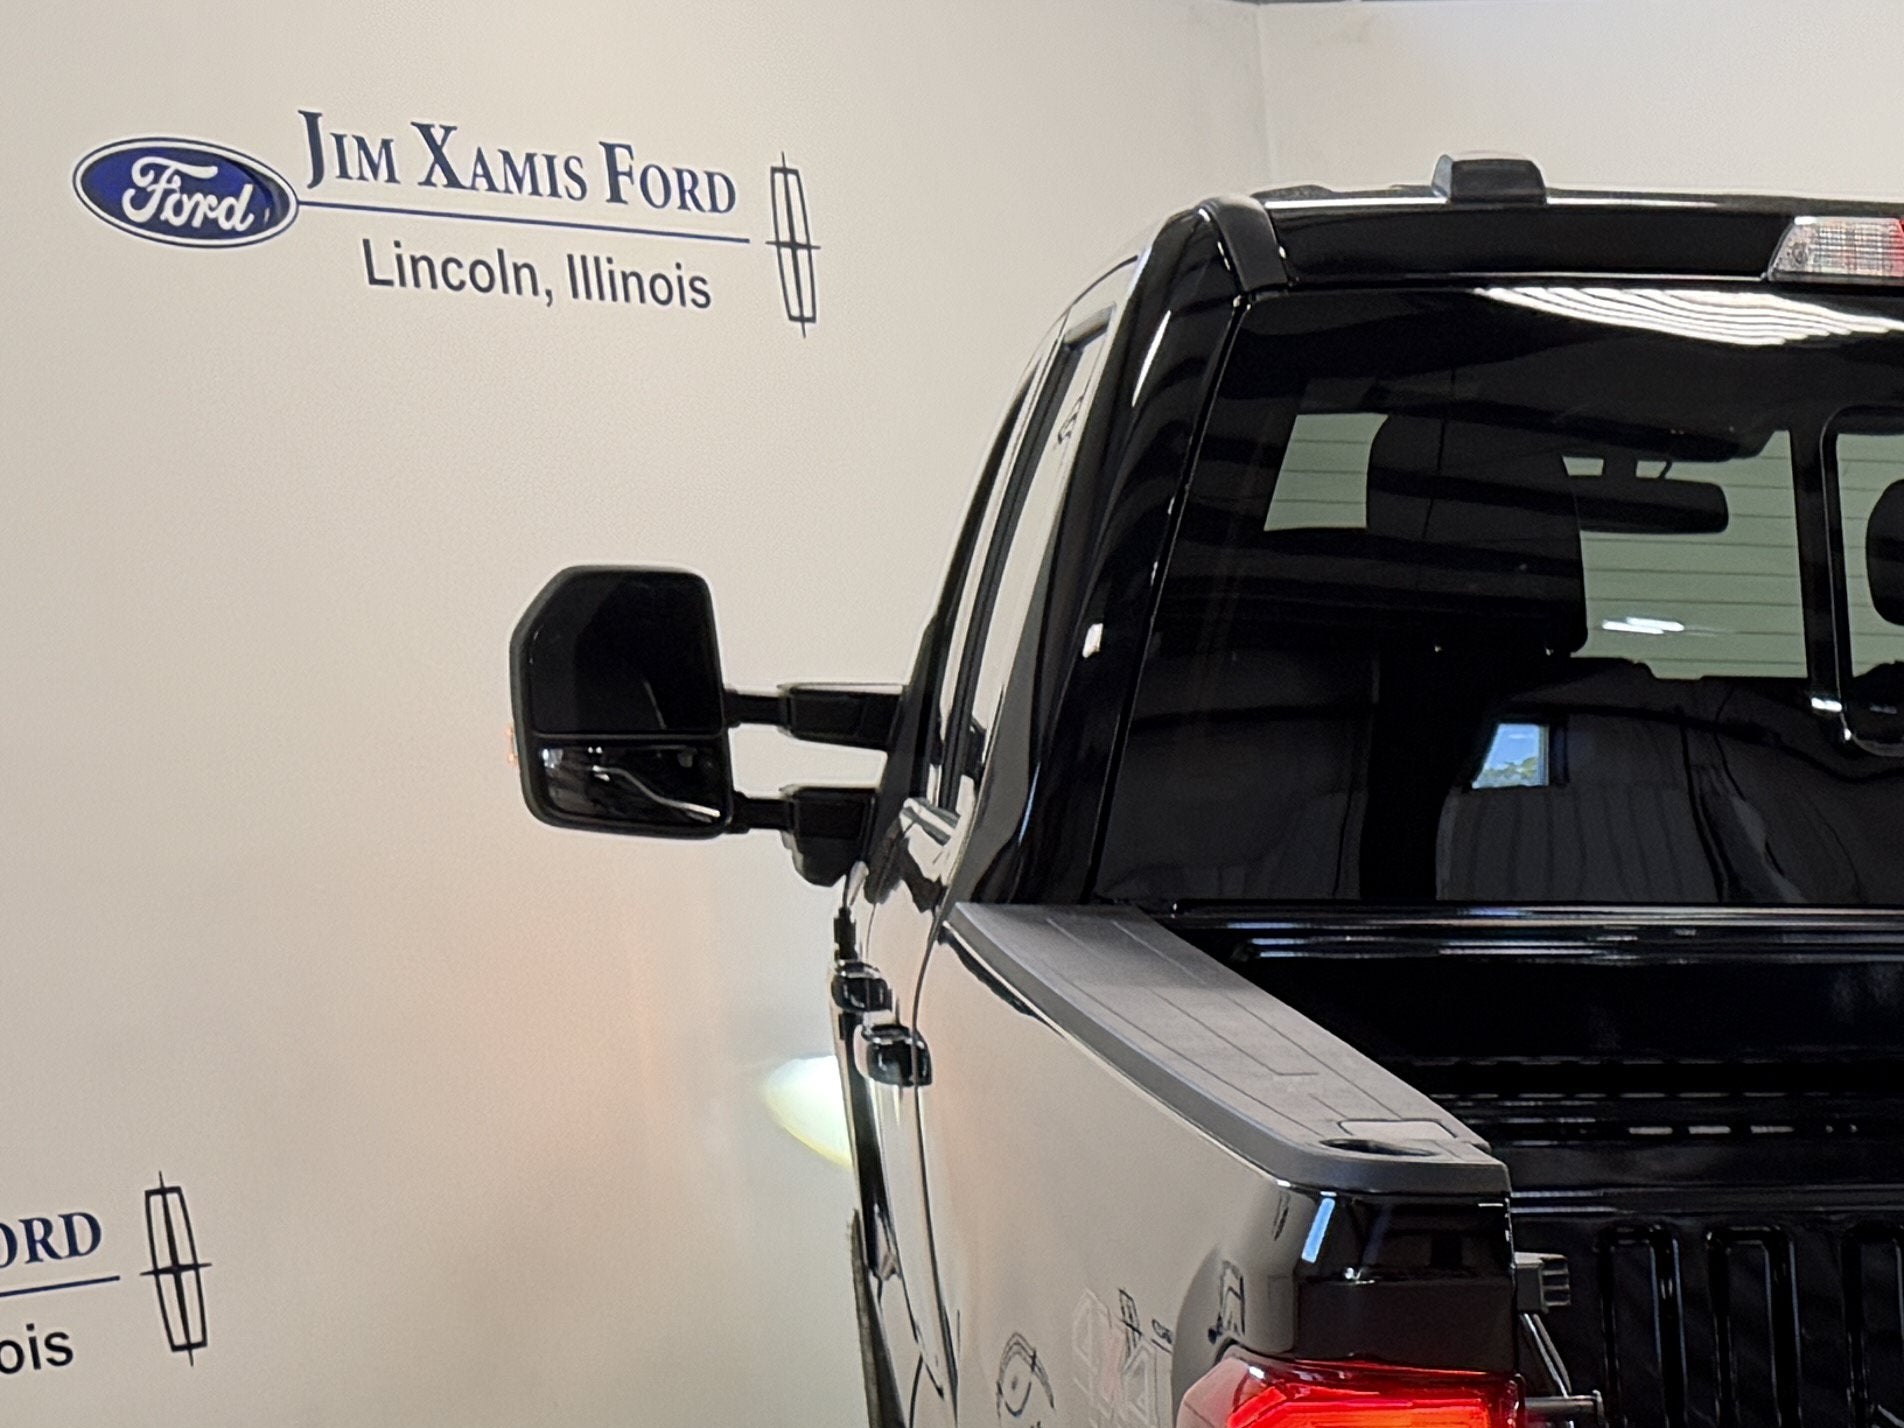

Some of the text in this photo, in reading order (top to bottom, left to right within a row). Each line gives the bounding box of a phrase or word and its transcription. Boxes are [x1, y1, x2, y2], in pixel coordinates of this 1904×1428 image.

[121, 156, 255, 232] Ford
[297, 109, 736, 215] JIM XAMIS FORD
[362, 238, 712, 309] Lincoln, Illinois
